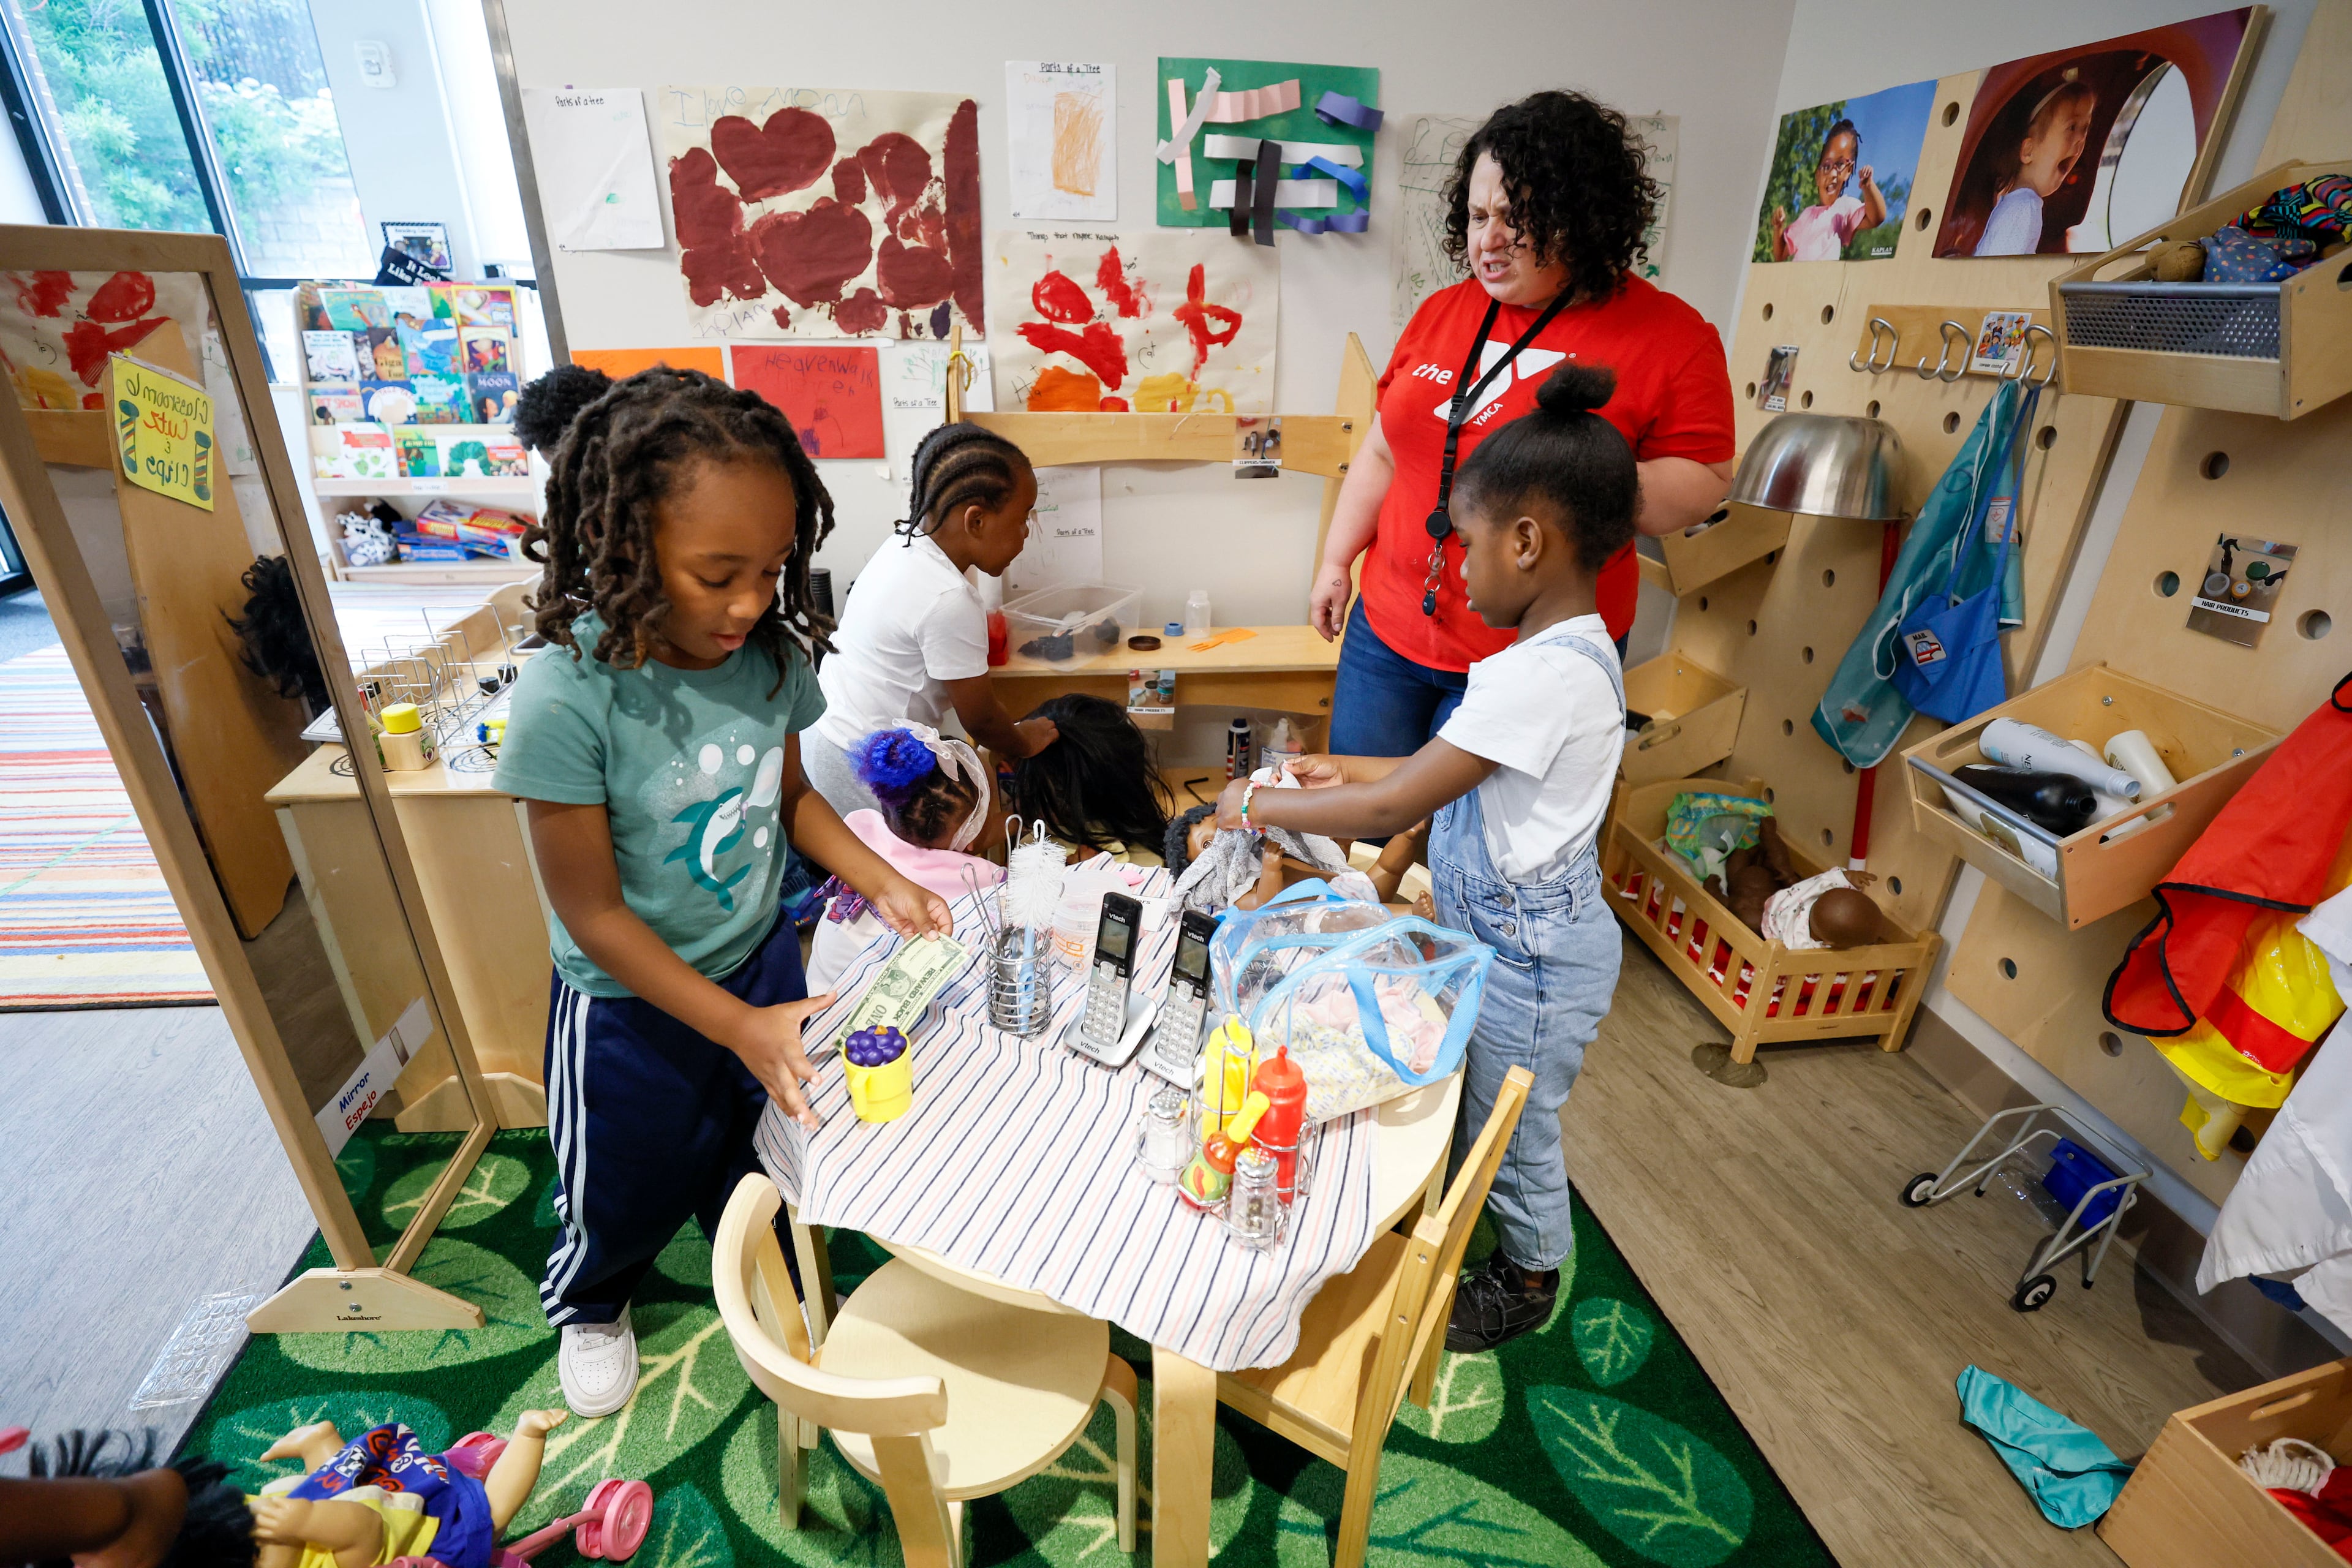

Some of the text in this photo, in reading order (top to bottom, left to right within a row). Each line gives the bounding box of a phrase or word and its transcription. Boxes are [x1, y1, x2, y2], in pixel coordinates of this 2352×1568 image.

[1041, 62, 1061, 72] Parts
[1067, 64, 1072, 73] of
[1083, 64, 1101, 73] Tree
[556, 96, 573, 107] Parts
[587, 96, 605, 105] tree
[406, 260, 417, 273] It
[1412, 363, 1453, 385] the
[477, 377, 511, 386] MOON
[894, 397, 908, 407] Parts
[1472, 403, 1504, 427] YMCA
[2216, 604, 2250, 616] PRODUCTS
[1912, 632, 1928, 641] MAIL
[1109, 913, 1125, 923] vtech
[1187, 930, 1204, 943] vtech
[892, 967, 936, 1021] REWARD BUCK
[865, 1004, 888, 1027] ONE
[1080, 1041, 1100, 1055] vtech
[1154, 1061, 1174, 1076] vtech
[339, 1072, 369, 1114] Mirror
[345, 1090, 377, 1131] Espejo
